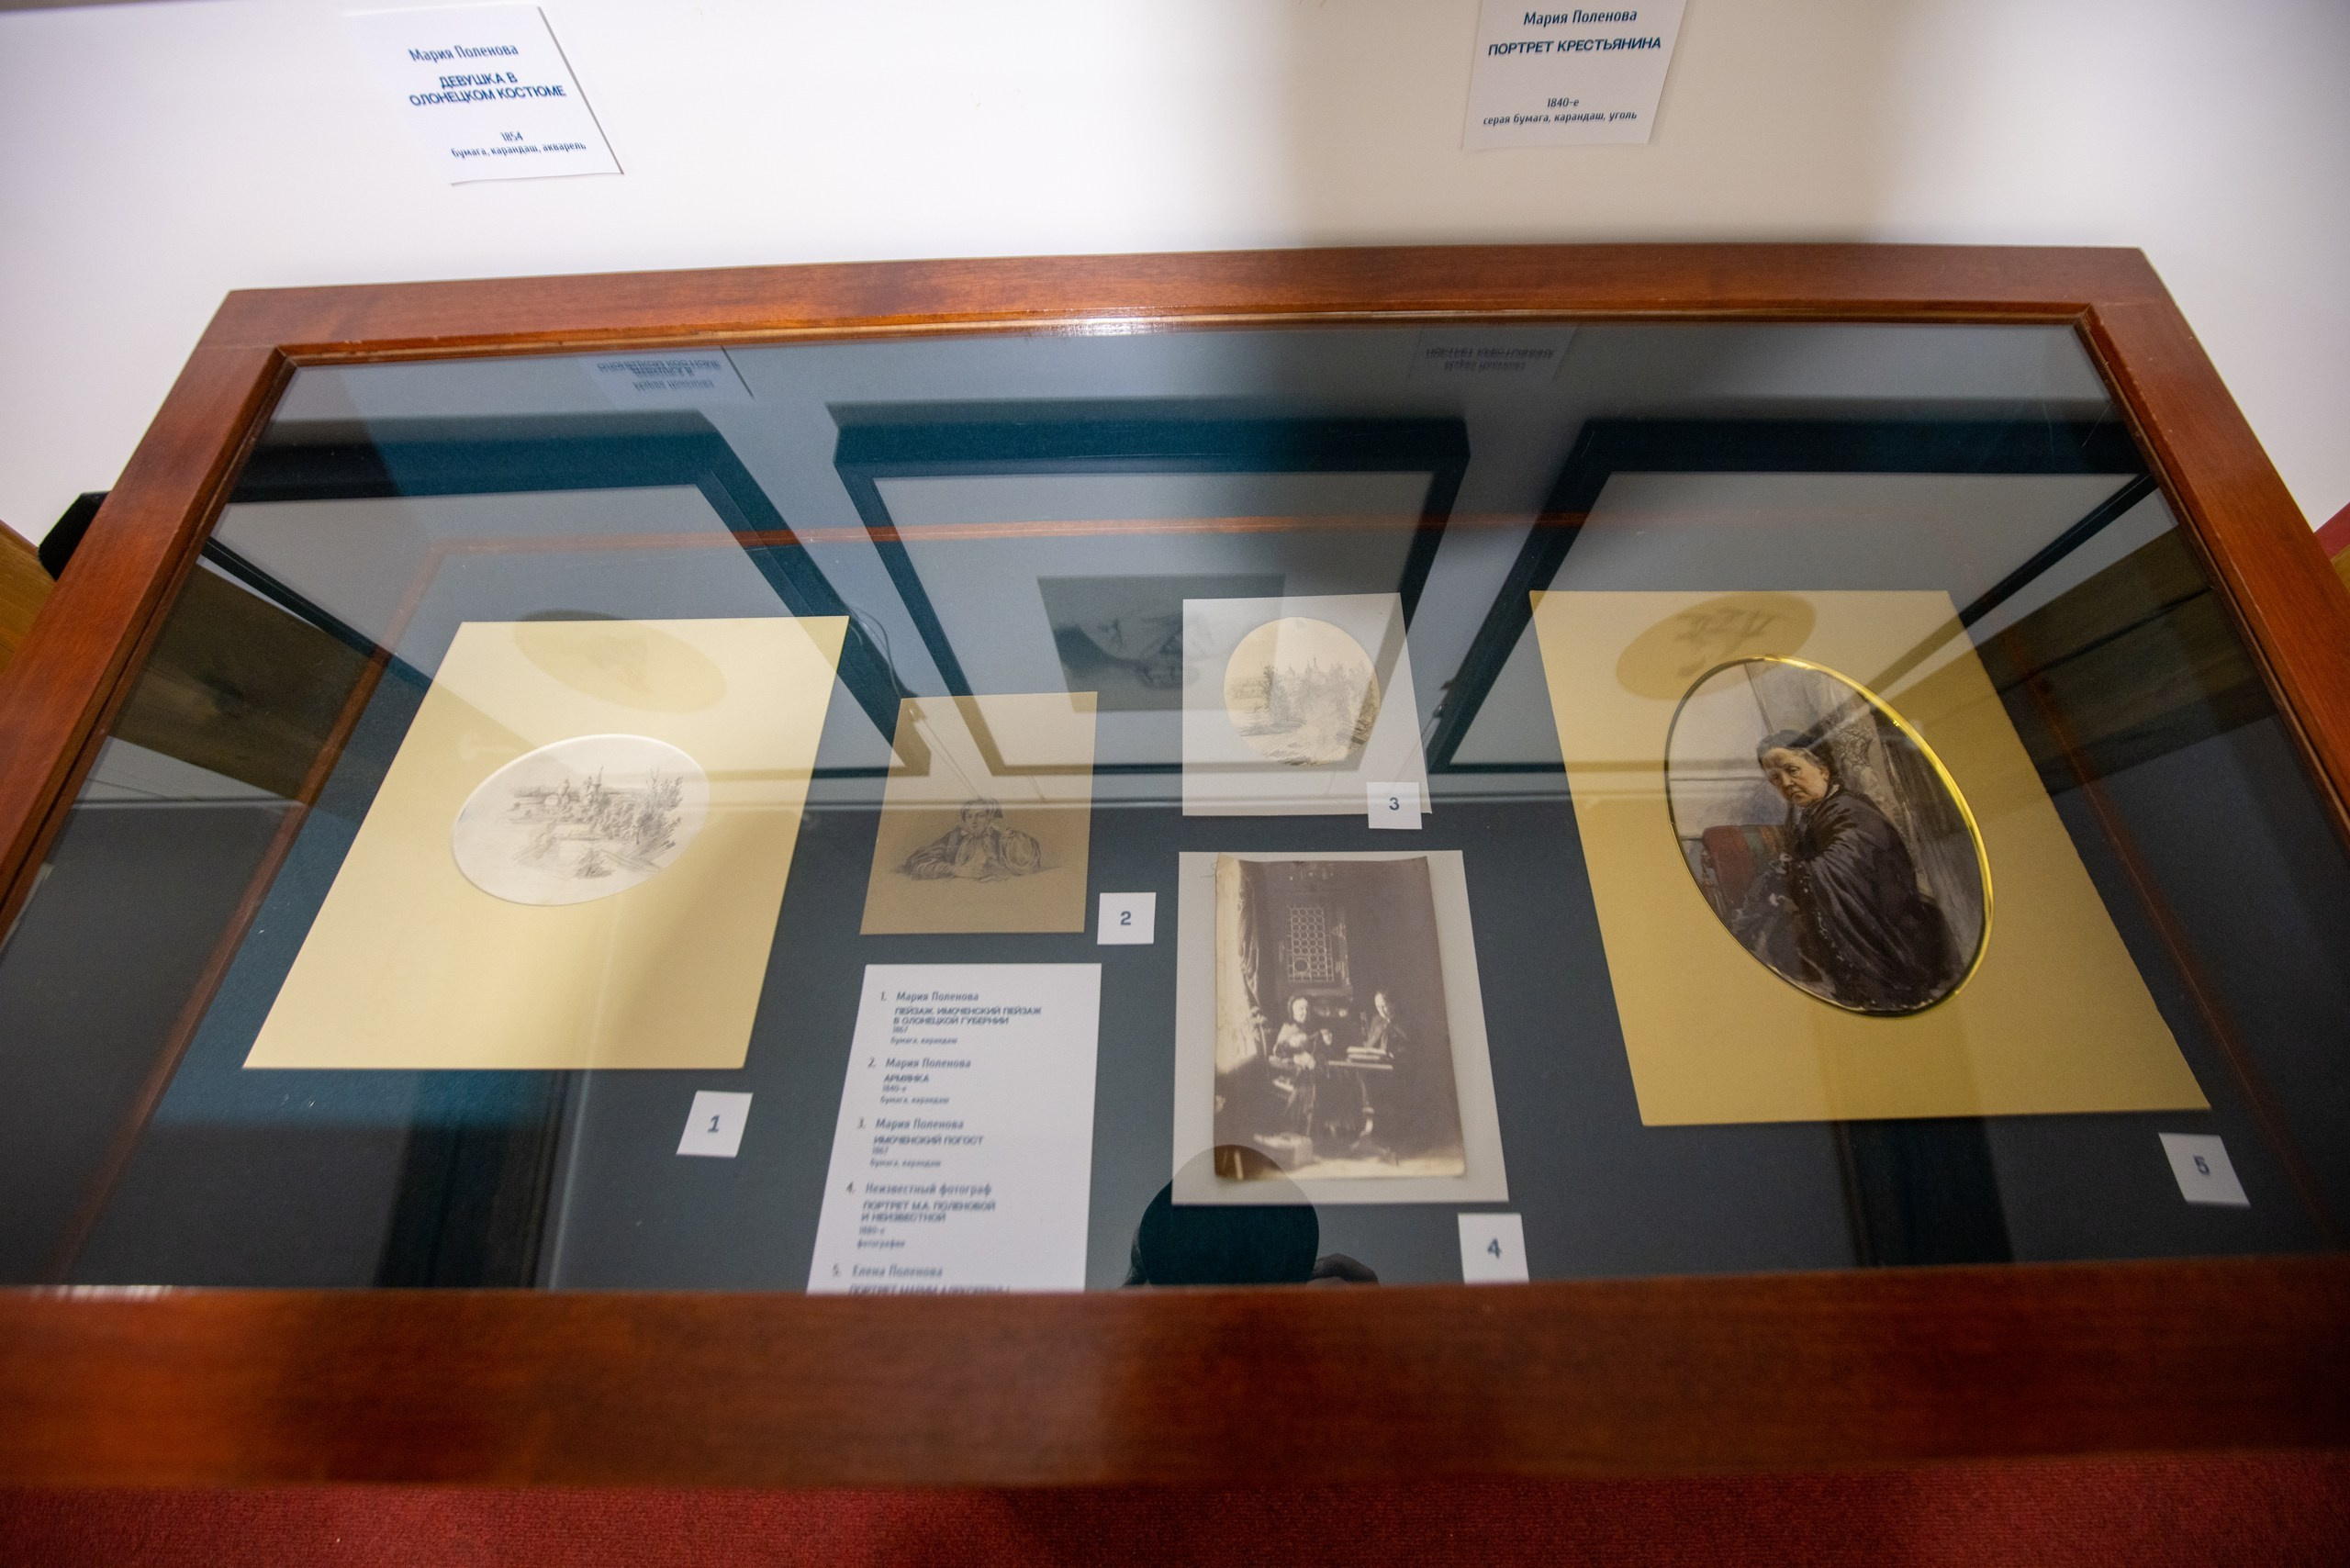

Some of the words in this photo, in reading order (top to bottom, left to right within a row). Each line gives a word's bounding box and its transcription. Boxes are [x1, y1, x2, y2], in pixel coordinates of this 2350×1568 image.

[1524, 11, 1568, 28] Мария
[1572, 9, 1638, 24] Поленова
[408, 47, 454, 63] Мария
[454, 44, 519, 59] Поленова
[1488, 41, 1554, 56] ПОРТРЕТ
[1557, 37, 1662, 52] КРЕСТЬЯНИНА
[439, 73, 505, 89] ДЕВУШКА
[506, 72, 519, 84] В
[408, 88, 496, 106] ОЛОНЕЦКОМ
[498, 85, 567, 99] КОСТЮМЕ
[1547, 97, 1579, 107] 1840-е
[1483, 115, 1510, 126] серая
[1513, 113, 1551, 125] бумага,
[1554, 112, 1606, 123] карандаш,
[1609, 111, 1637, 121] уголь
[501, 131, 523, 142] 1854
[451, 147, 490, 159] бумага,
[490, 144, 541, 157] карандаш,
[543, 141, 587, 153] акварель
[1389, 797, 1400, 811] 3
[1120, 911, 1132, 926] 2
[896, 991, 929, 1003] Мария
[932, 991, 979, 1002] Поленова
[1002, 1006, 1042, 1015] ПЕЙЗАЖ
[885, 1058, 919, 1070] Мария
[922, 1057, 972, 1069] Поленова
[708, 1114, 721, 1133] 1
[875, 1117, 910, 1131] Мария
[912, 1117, 964, 1129] Поленова
[2193, 1156, 2210, 1175] 5
[939, 1182, 991, 1197] фотограф
[863, 1200, 910, 1211] ПОРТРЕТ
[1487, 1238, 1502, 1259] 4
[852, 1264, 886, 1278] Елена
[889, 1263, 944, 1278] Поленова
